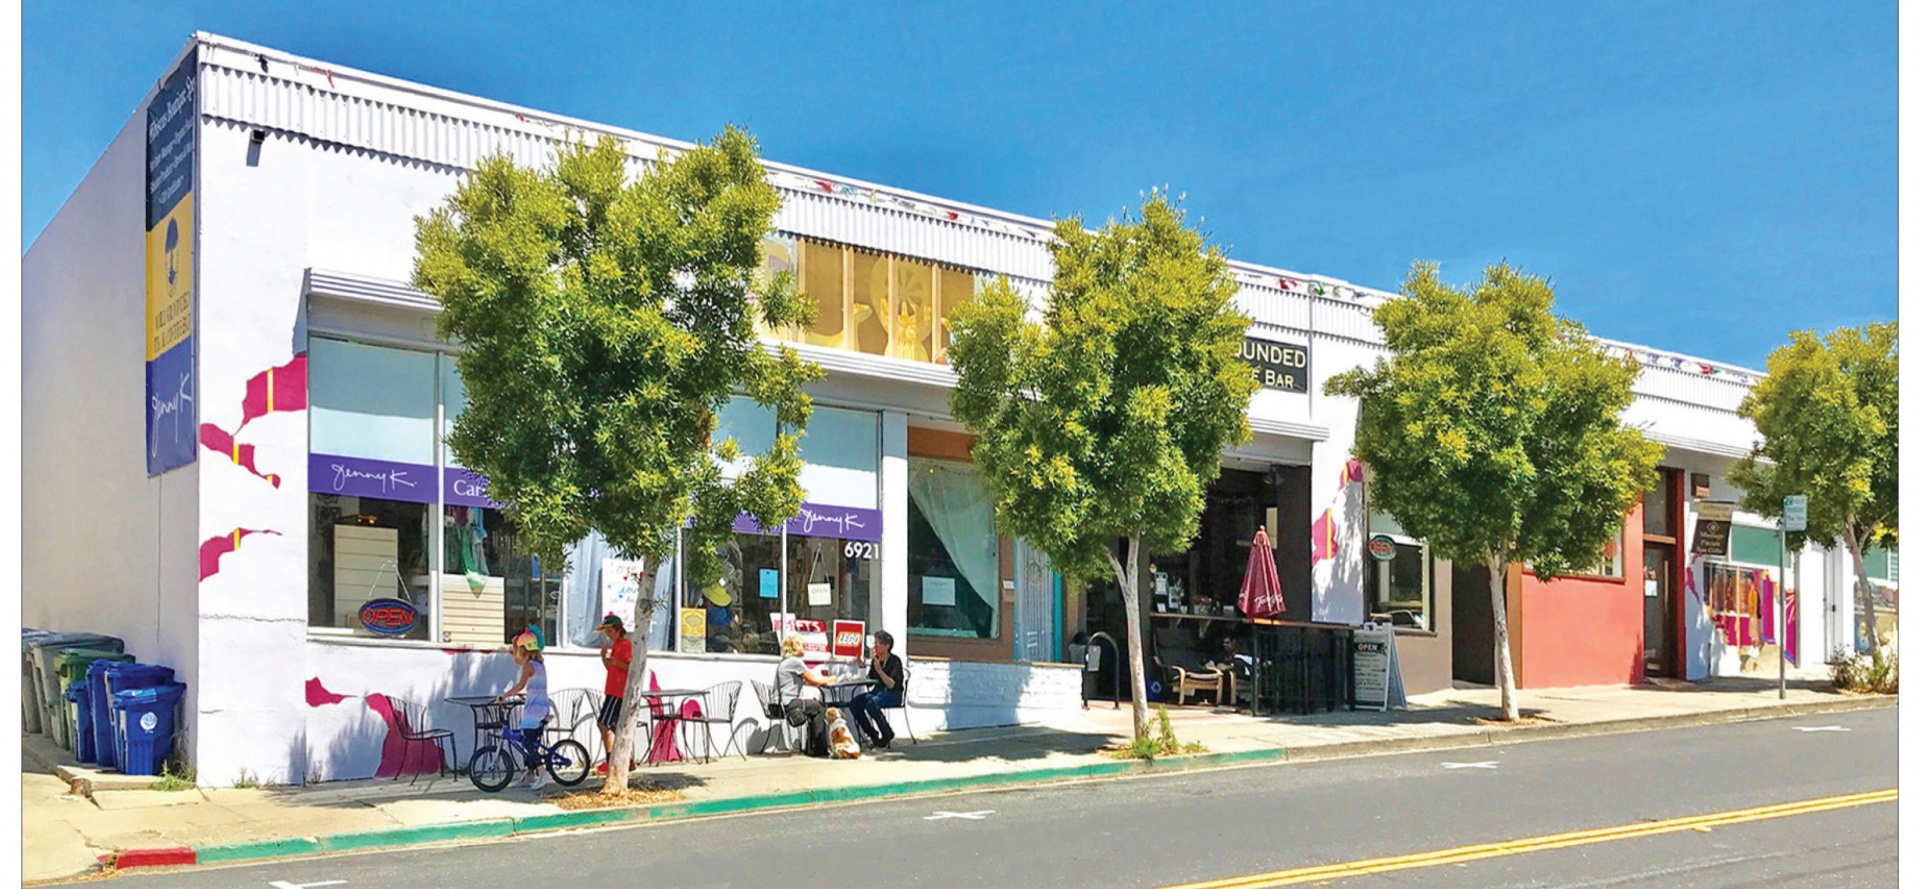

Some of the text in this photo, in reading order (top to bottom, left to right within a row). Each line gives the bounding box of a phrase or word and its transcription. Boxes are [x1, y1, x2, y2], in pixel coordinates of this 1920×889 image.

[1265, 369, 1294, 389] BAR
[331, 463, 386, 493] Jenny
[801, 507, 843, 534] Jenny
[844, 541, 880, 559] 6921
[361, 608, 415, 627] OPEN
[837, 634, 861, 644] LEGO
[1357, 643, 1378, 651] OPEN
